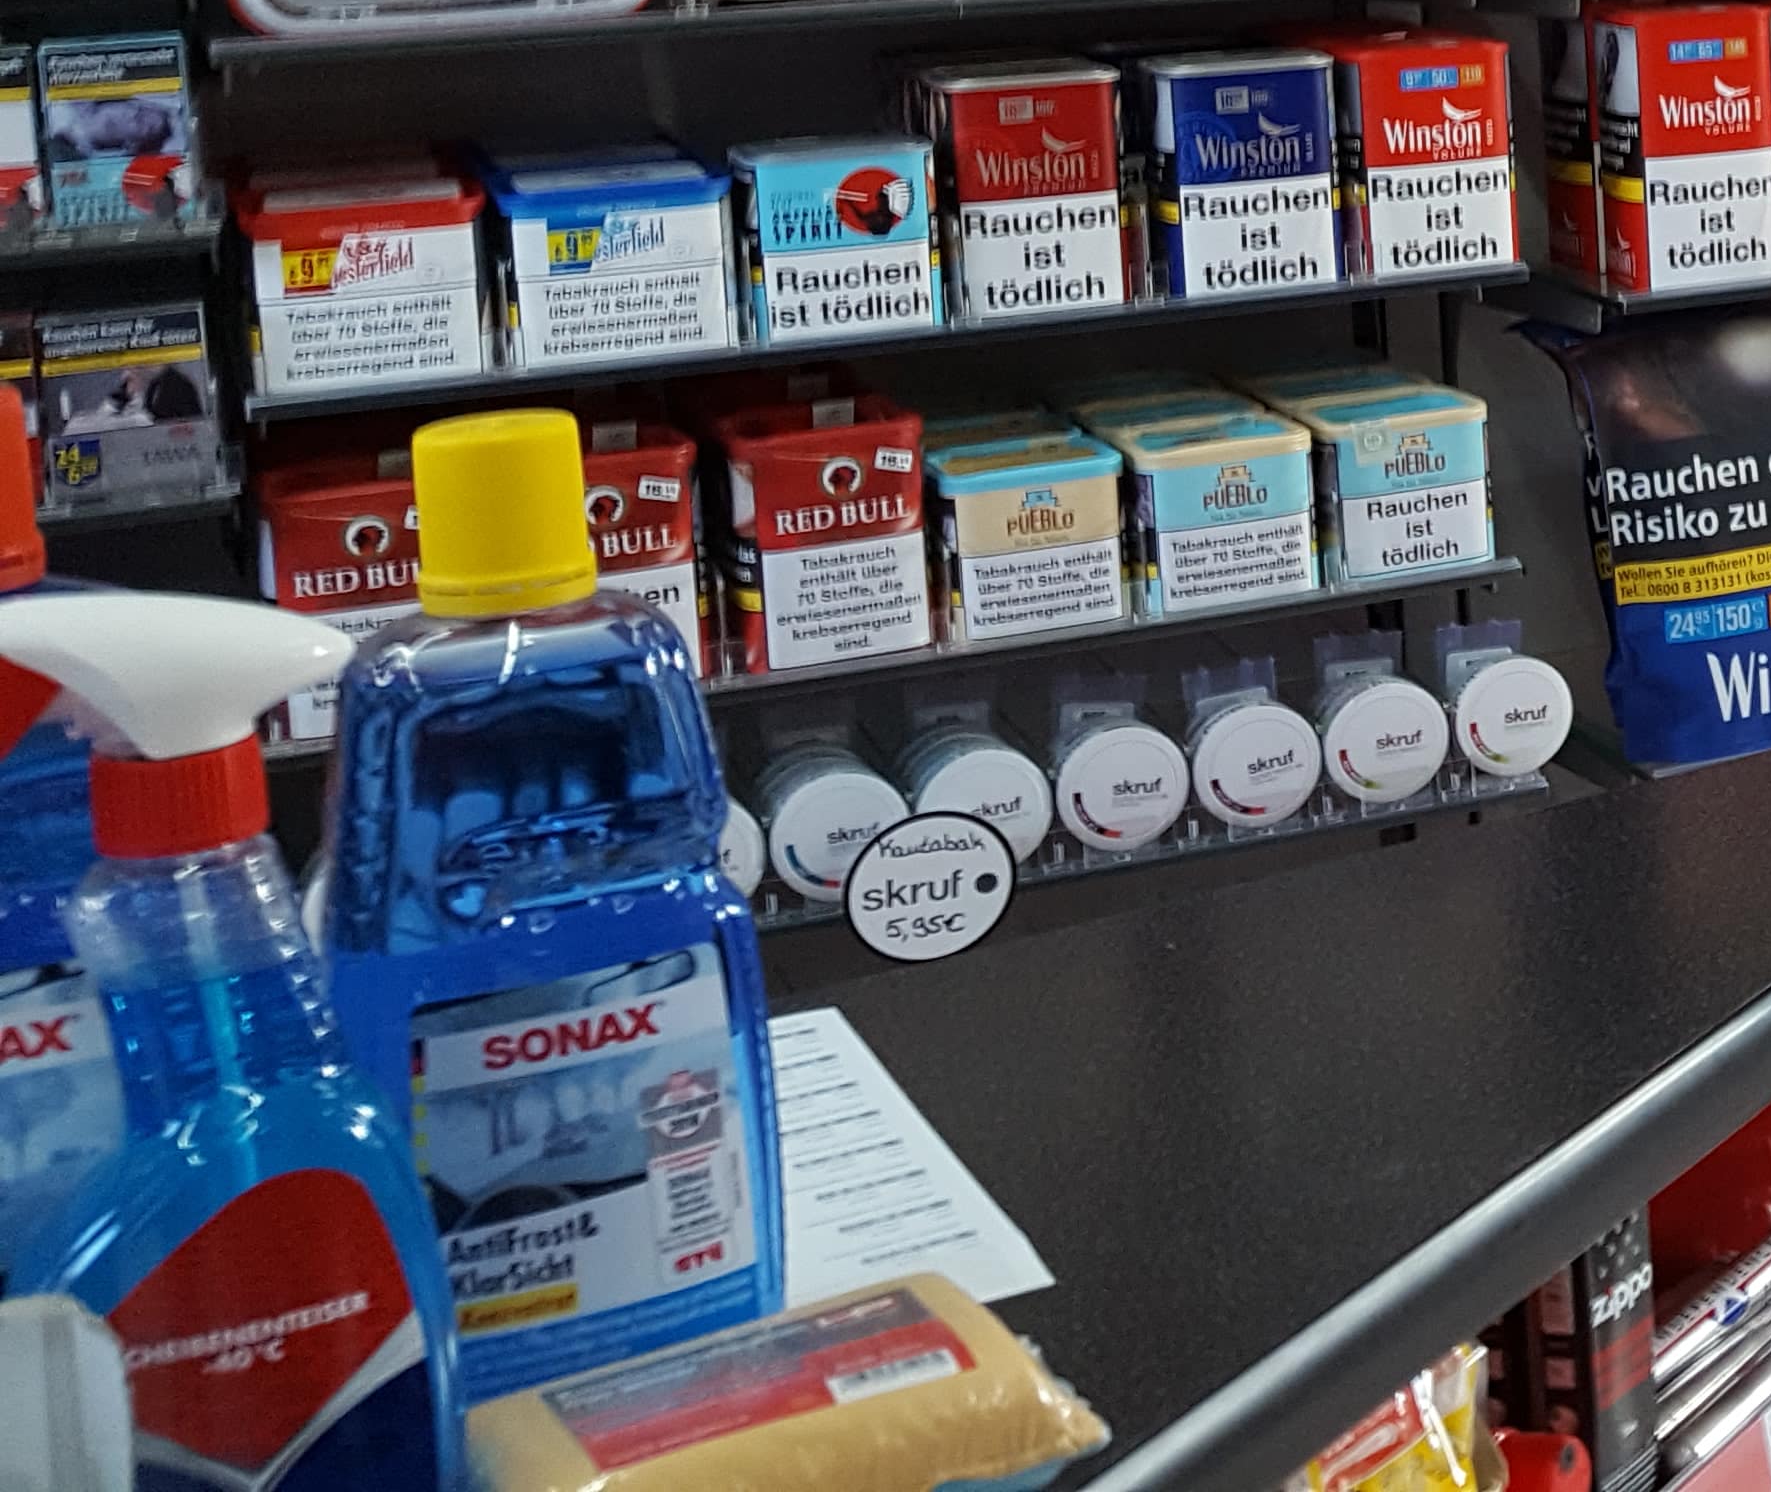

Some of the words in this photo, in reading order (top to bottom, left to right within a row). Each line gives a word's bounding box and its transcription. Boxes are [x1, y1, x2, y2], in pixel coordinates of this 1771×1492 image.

[1370, 169, 1507, 200] Rauchen
[1183, 187, 1329, 219] Rauchen
[1425, 205, 1463, 231] ist
[964, 204, 1116, 237] Rauchen
[1391, 235, 1498, 267] tödlich
[775, 262, 921, 293] Rauchen
[821, 292, 929, 323] tödlich
[1606, 454, 1759, 504] Rauchen
[775, 506, 835, 536] RED
[840, 495, 911, 527] BULL
[1366, 490, 1470, 521] Rauchen
[602, 525, 676, 555] BULL
[1405, 518, 1436, 540] ist
[1610, 503, 1719, 548] Risiko
[1728, 504, 1768, 533] zu
[1381, 539, 1460, 569] tödlich
[1688, 555, 1754, 576] aufhören?
[293, 571, 354, 599] RED
[1716, 605, 1751, 631] 150
[1503, 704, 1549, 726] skruf
[1375, 728, 1423, 752] skruf
[1247, 750, 1295, 774] skruf
[1112, 776, 1163, 798] skruf
[861, 868, 964, 911] skruf
[482, 999, 665, 1072] SONAX
